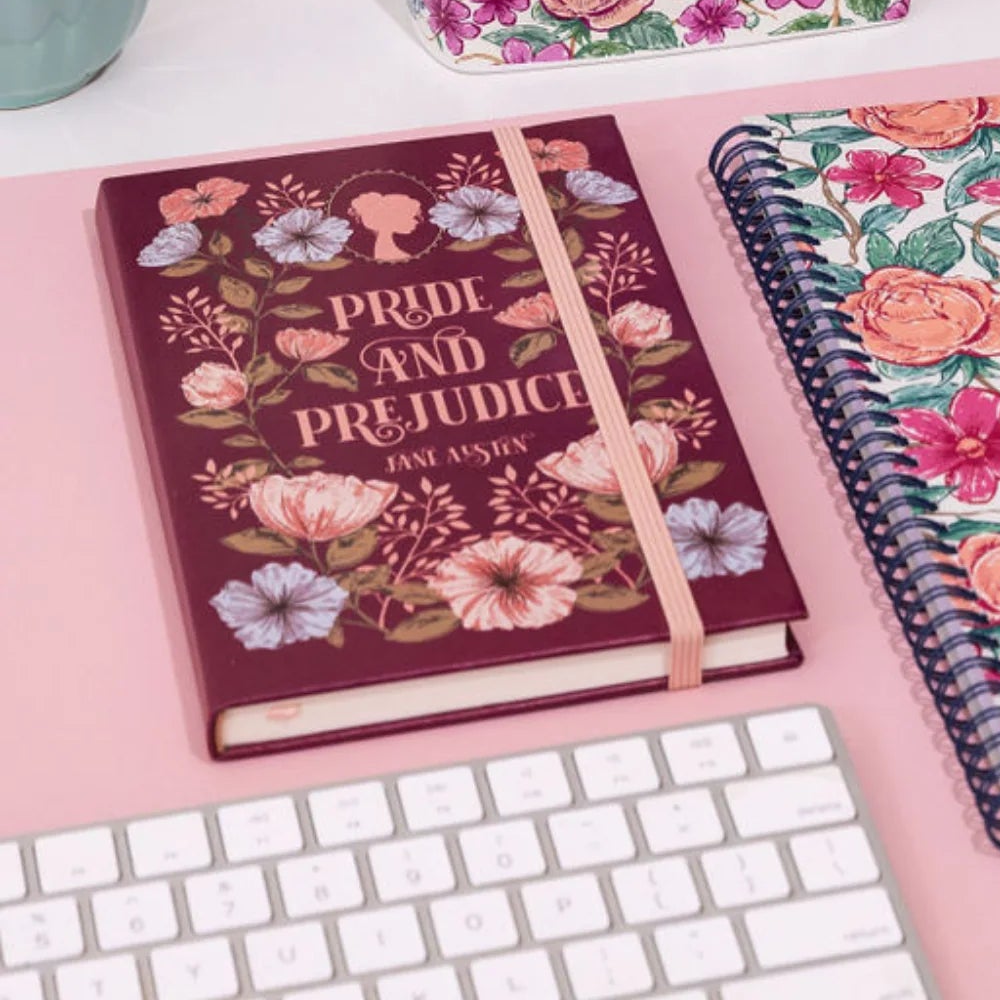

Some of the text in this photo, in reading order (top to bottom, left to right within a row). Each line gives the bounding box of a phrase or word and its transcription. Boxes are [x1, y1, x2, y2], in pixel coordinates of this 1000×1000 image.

[328, 276, 493, 331] PRIDE
[360, 325, 486, 386] AND
[291, 369, 592, 448] PREJUDICE
[384, 432, 536, 474] JANE AUSTEN
